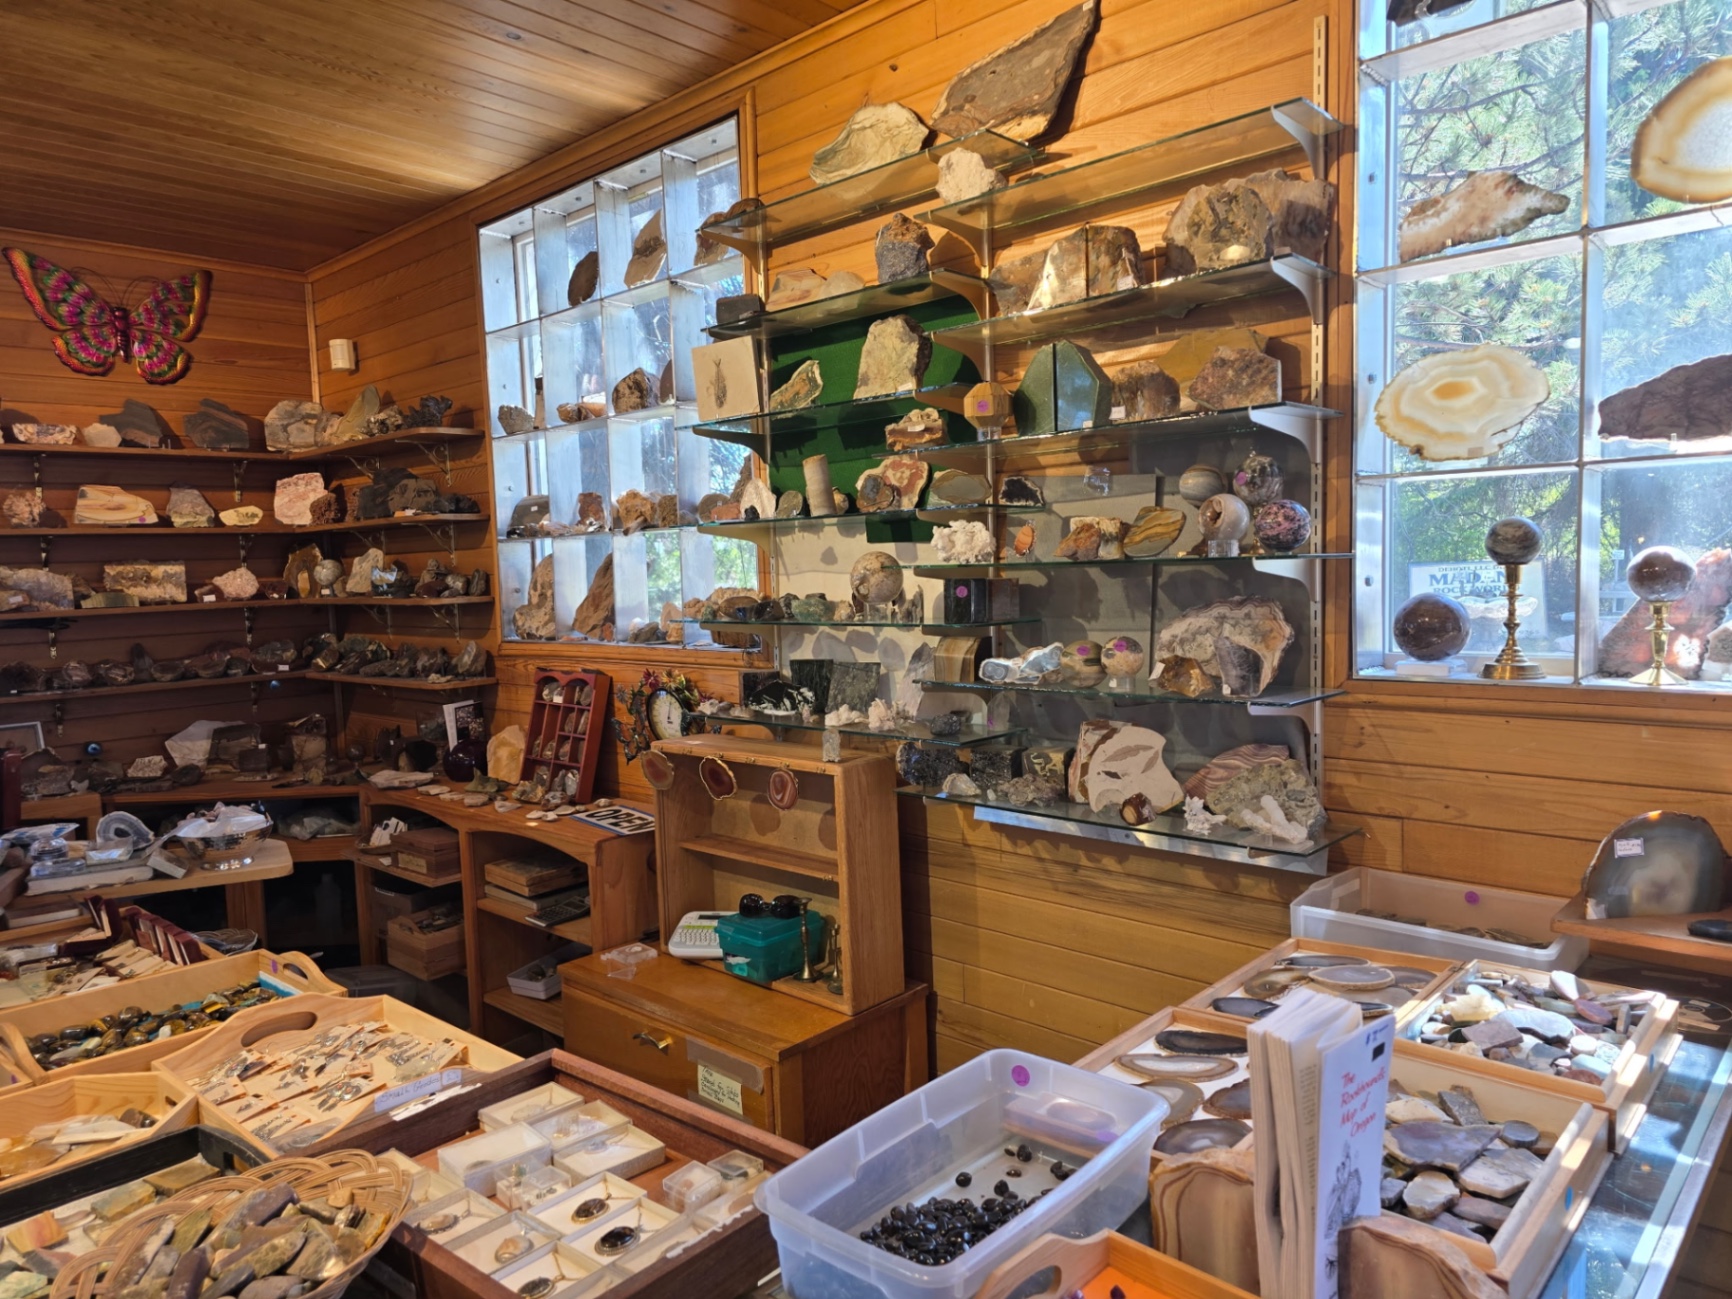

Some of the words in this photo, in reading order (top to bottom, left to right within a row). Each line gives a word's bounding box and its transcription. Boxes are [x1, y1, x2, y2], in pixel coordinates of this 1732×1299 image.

[585, 809, 655, 832] OPEN
[1341, 1071, 1356, 1088] The
[1340, 1108, 1358, 1128] Map
[1360, 1091, 1371, 1112] of
[1350, 1112, 1377, 1138] Oregon
